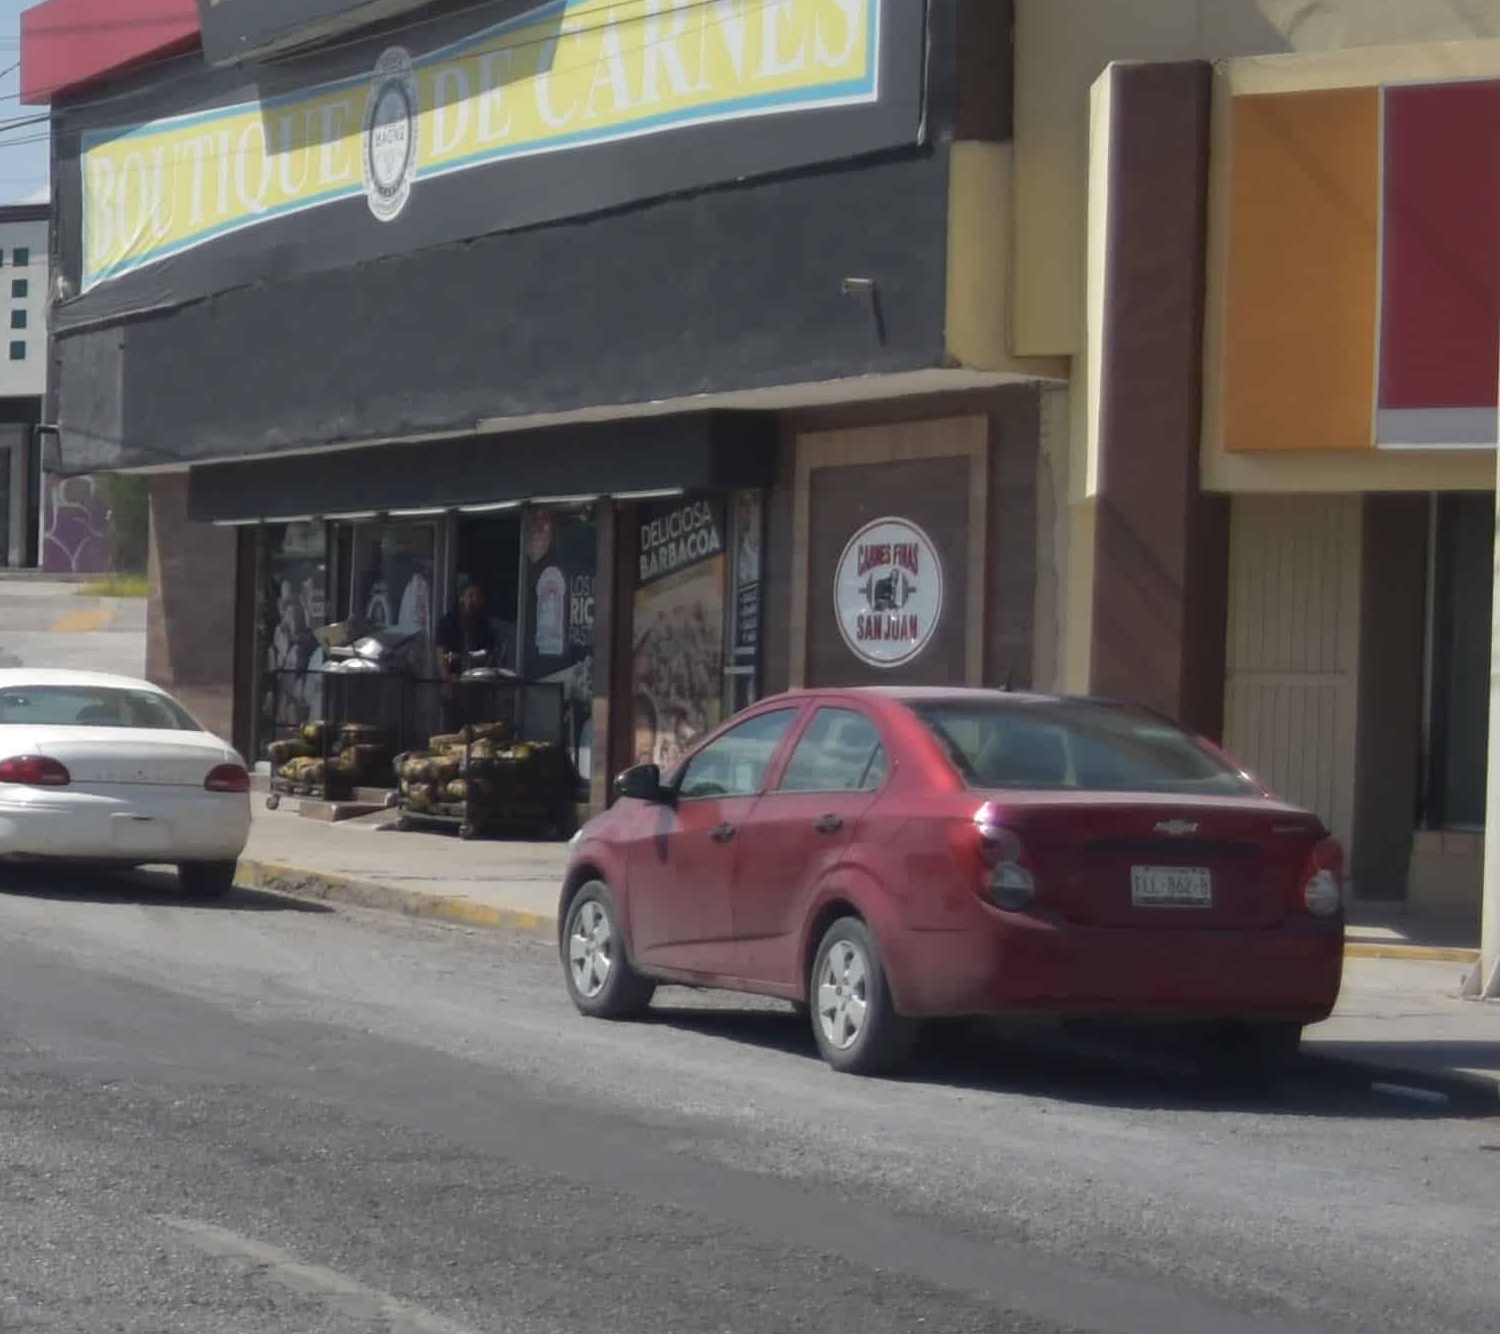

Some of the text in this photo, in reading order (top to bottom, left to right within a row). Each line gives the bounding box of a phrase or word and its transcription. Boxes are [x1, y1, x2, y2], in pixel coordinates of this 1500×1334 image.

[88, 99, 354, 263] BOUTIQUE
[430, 47, 511, 158] DE
[641, 499, 713, 551] DELICIOSA
[639, 524, 721, 580] BARBACOA
[571, 596, 595, 624] RIC
[857, 615, 918, 641] SAN JUAN
